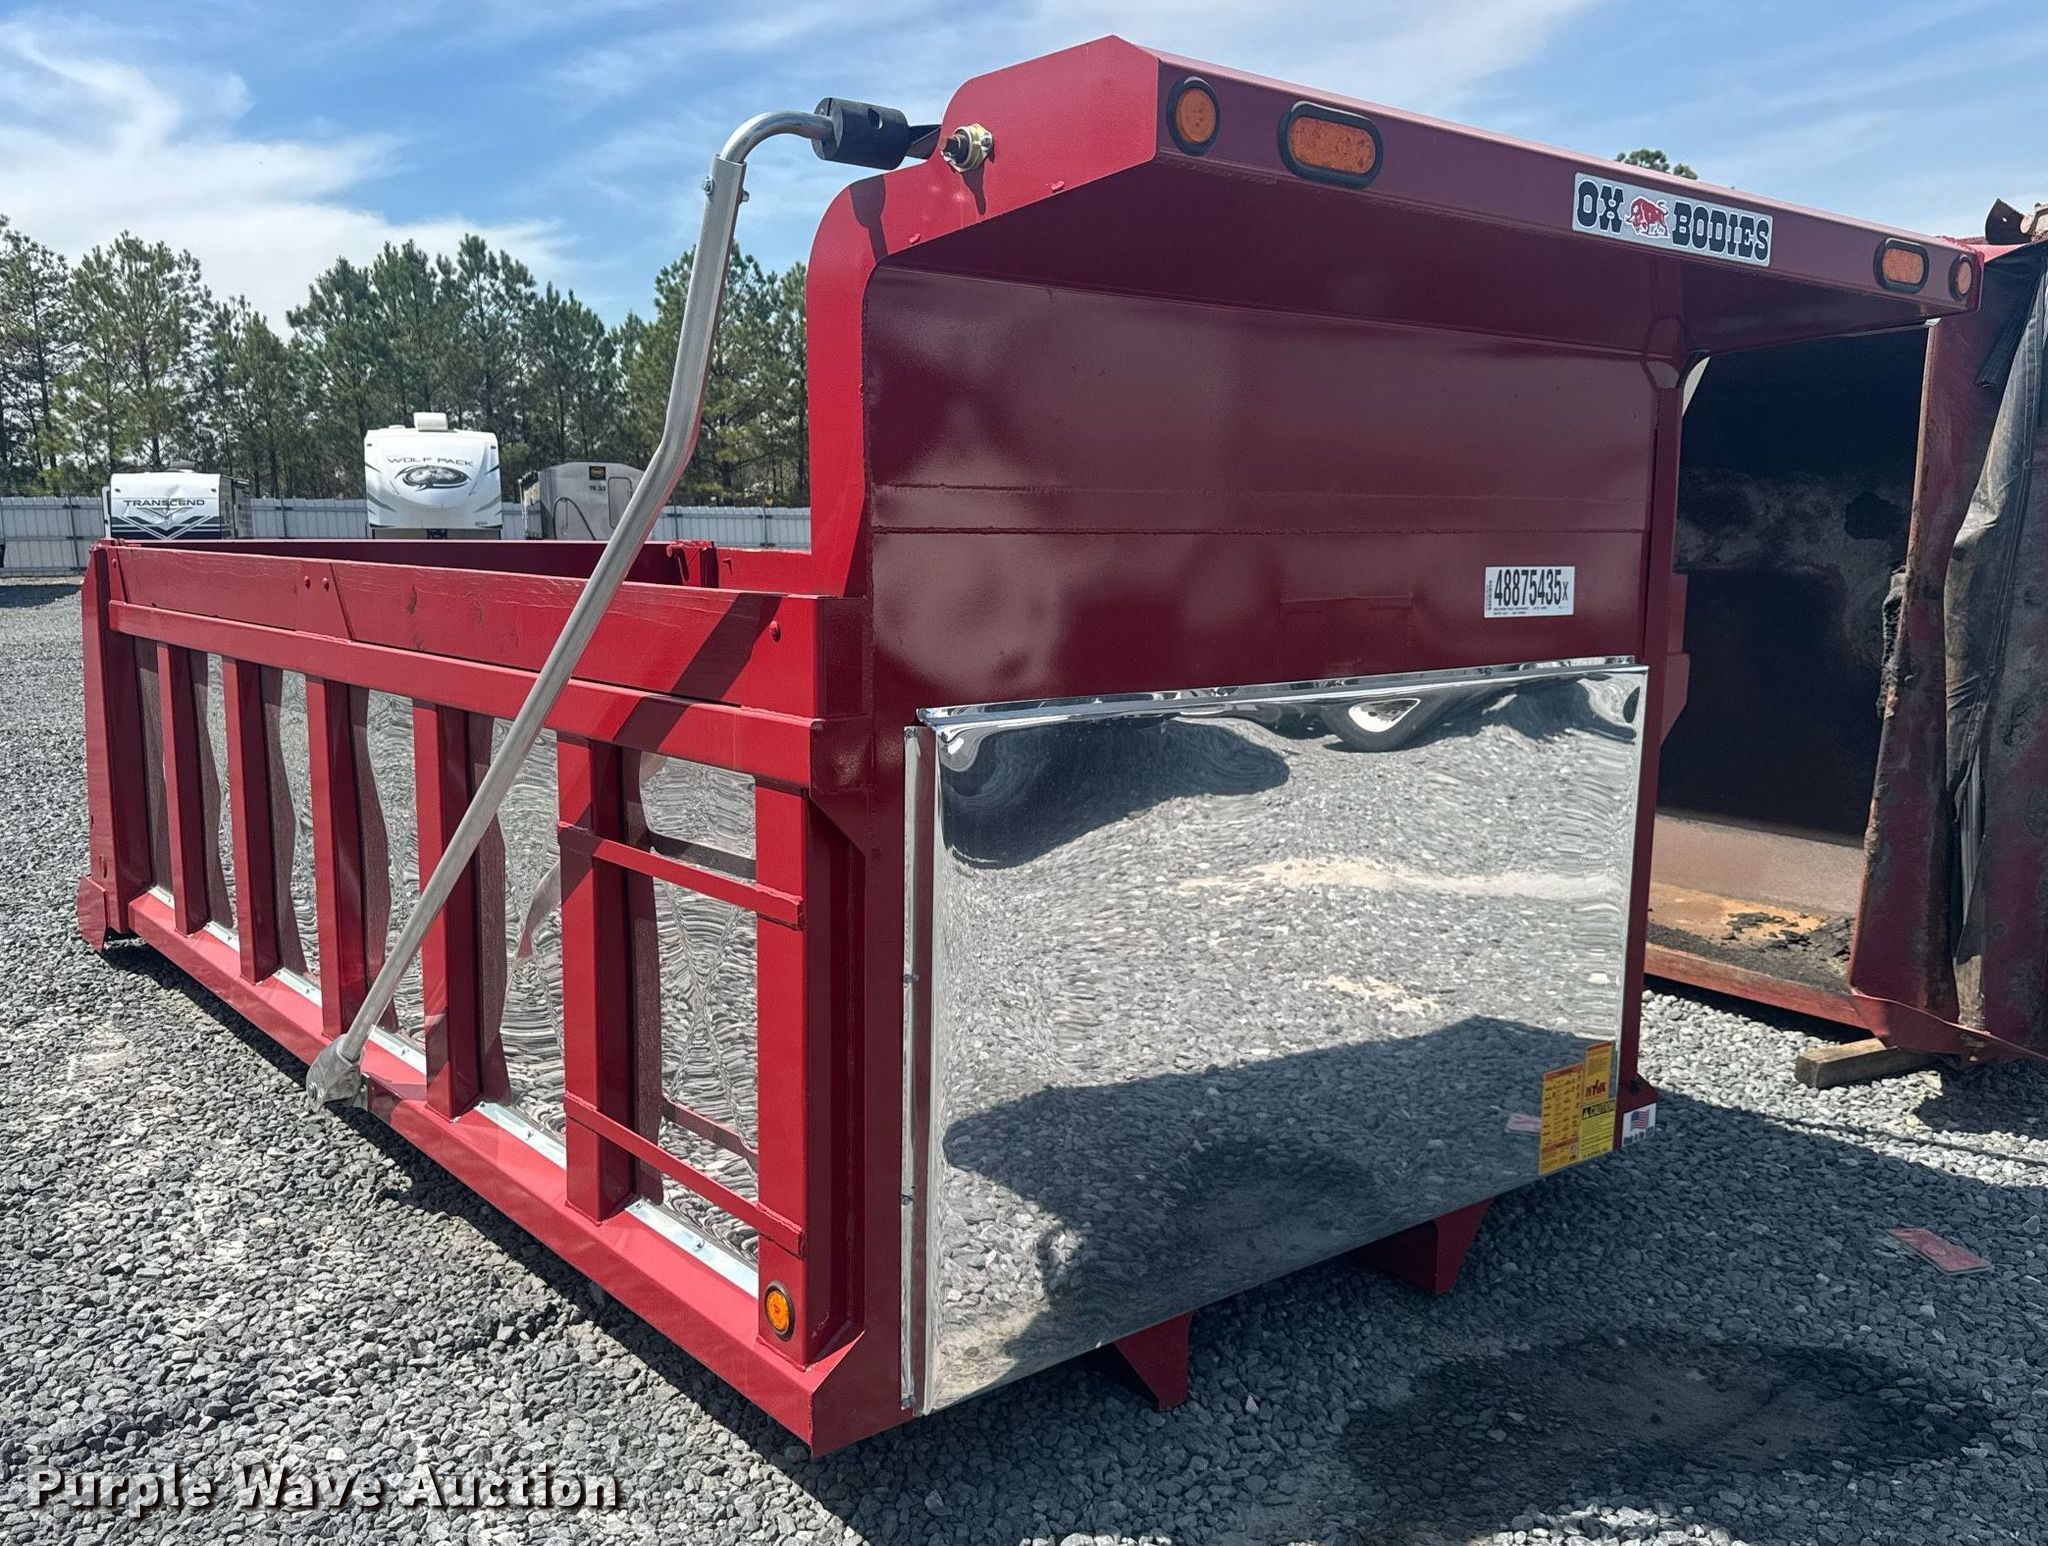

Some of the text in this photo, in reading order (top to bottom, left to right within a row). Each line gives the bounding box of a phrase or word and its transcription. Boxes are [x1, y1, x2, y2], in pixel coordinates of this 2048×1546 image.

[1576, 180, 1771, 261] OX BODIES
[437, 457, 474, 467] PACK
[123, 498, 205, 507] TRANSCEND
